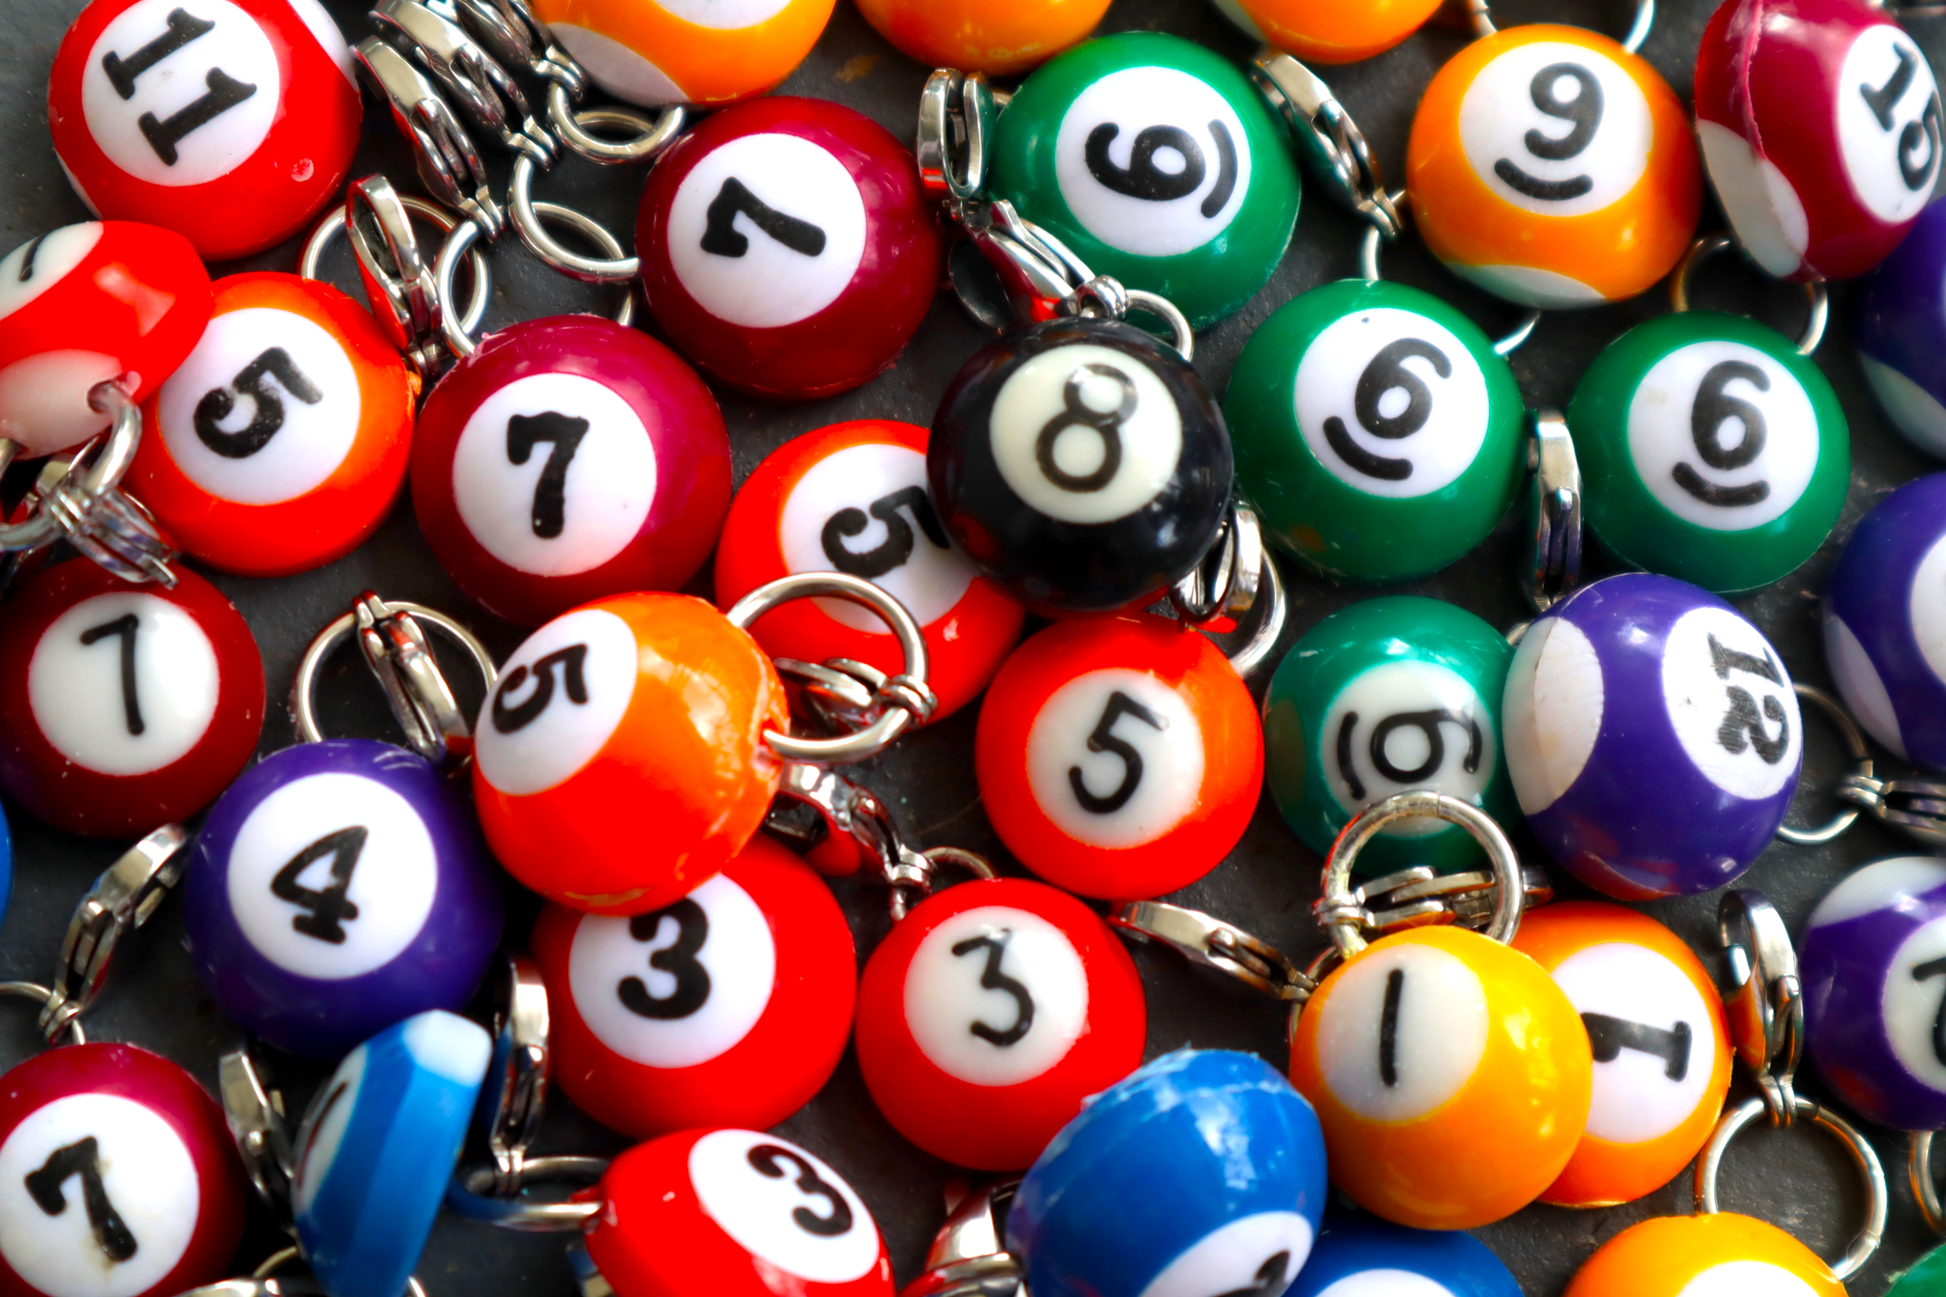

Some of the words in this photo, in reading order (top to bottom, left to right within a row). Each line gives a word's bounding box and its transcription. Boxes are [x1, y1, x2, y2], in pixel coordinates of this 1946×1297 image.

[102, 7, 257, 166] 11
[1522, 62, 1605, 160] 9
[1859, 40, 1945, 190] 15
[700, 177, 826, 258] 7
[1084, 123, 1206, 201] 6
[193, 346, 323, 459] 5
[1035, 363, 1138, 494] 8
[1355, 337, 1453, 439] 6
[1688, 360, 1771, 470] 6
[507, 411, 589, 539] 7
[821, 486, 950, 578] 5
[79, 612, 145, 736] 7
[491, 643, 589, 734] 5
[1706, 631, 1789, 765] 12
[1068, 690, 1170, 814] 5
[271, 825, 368, 944] 4
[617, 897, 712, 1020] 3
[951, 928, 1035, 1047] 3
[1378, 968, 1405, 1088] 1
[1580, 1012, 1693, 1082] 1
[25, 1136, 138, 1262] 7
[748, 1144, 853, 1237] 3
